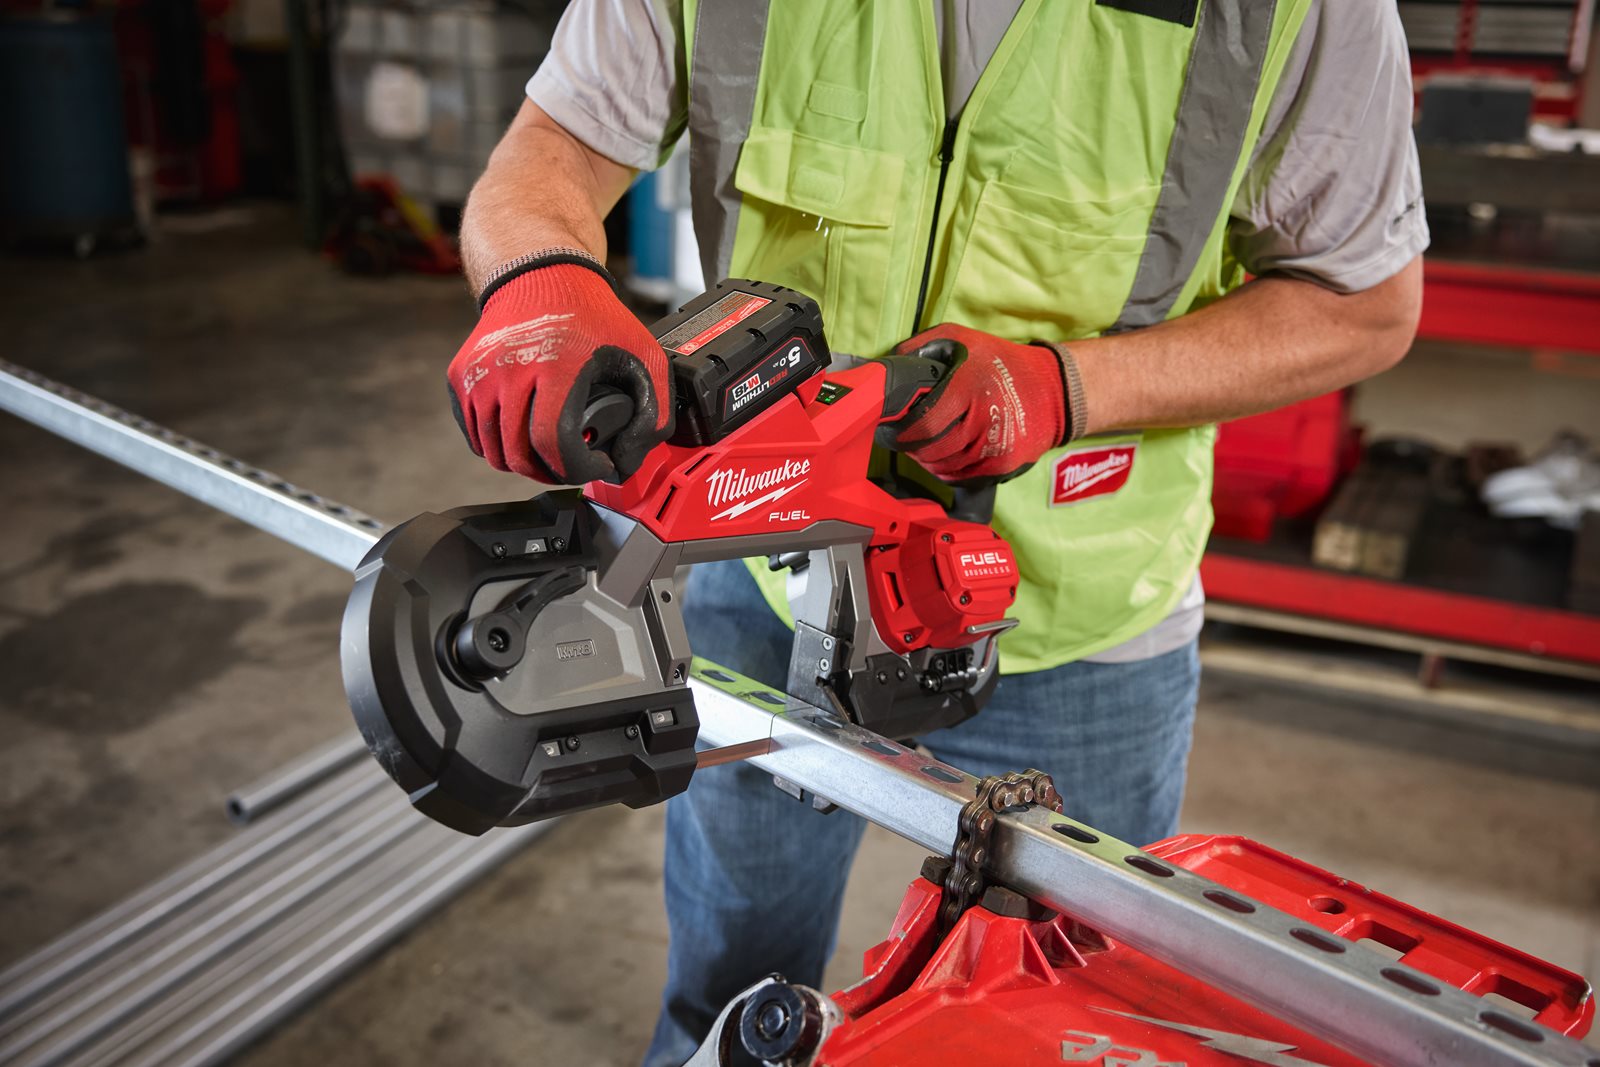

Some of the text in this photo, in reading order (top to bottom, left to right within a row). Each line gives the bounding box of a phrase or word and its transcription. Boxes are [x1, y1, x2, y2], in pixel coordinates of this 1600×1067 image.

[734, 375, 760, 399] M18
[1059, 452, 1130, 490] Milwaukee
[705, 459, 810, 507] Milwaukee
[768, 510, 811, 522] FUEL
[960, 552, 1007, 567] FUEL
[964, 566, 1010, 577] BRUSHLESS
